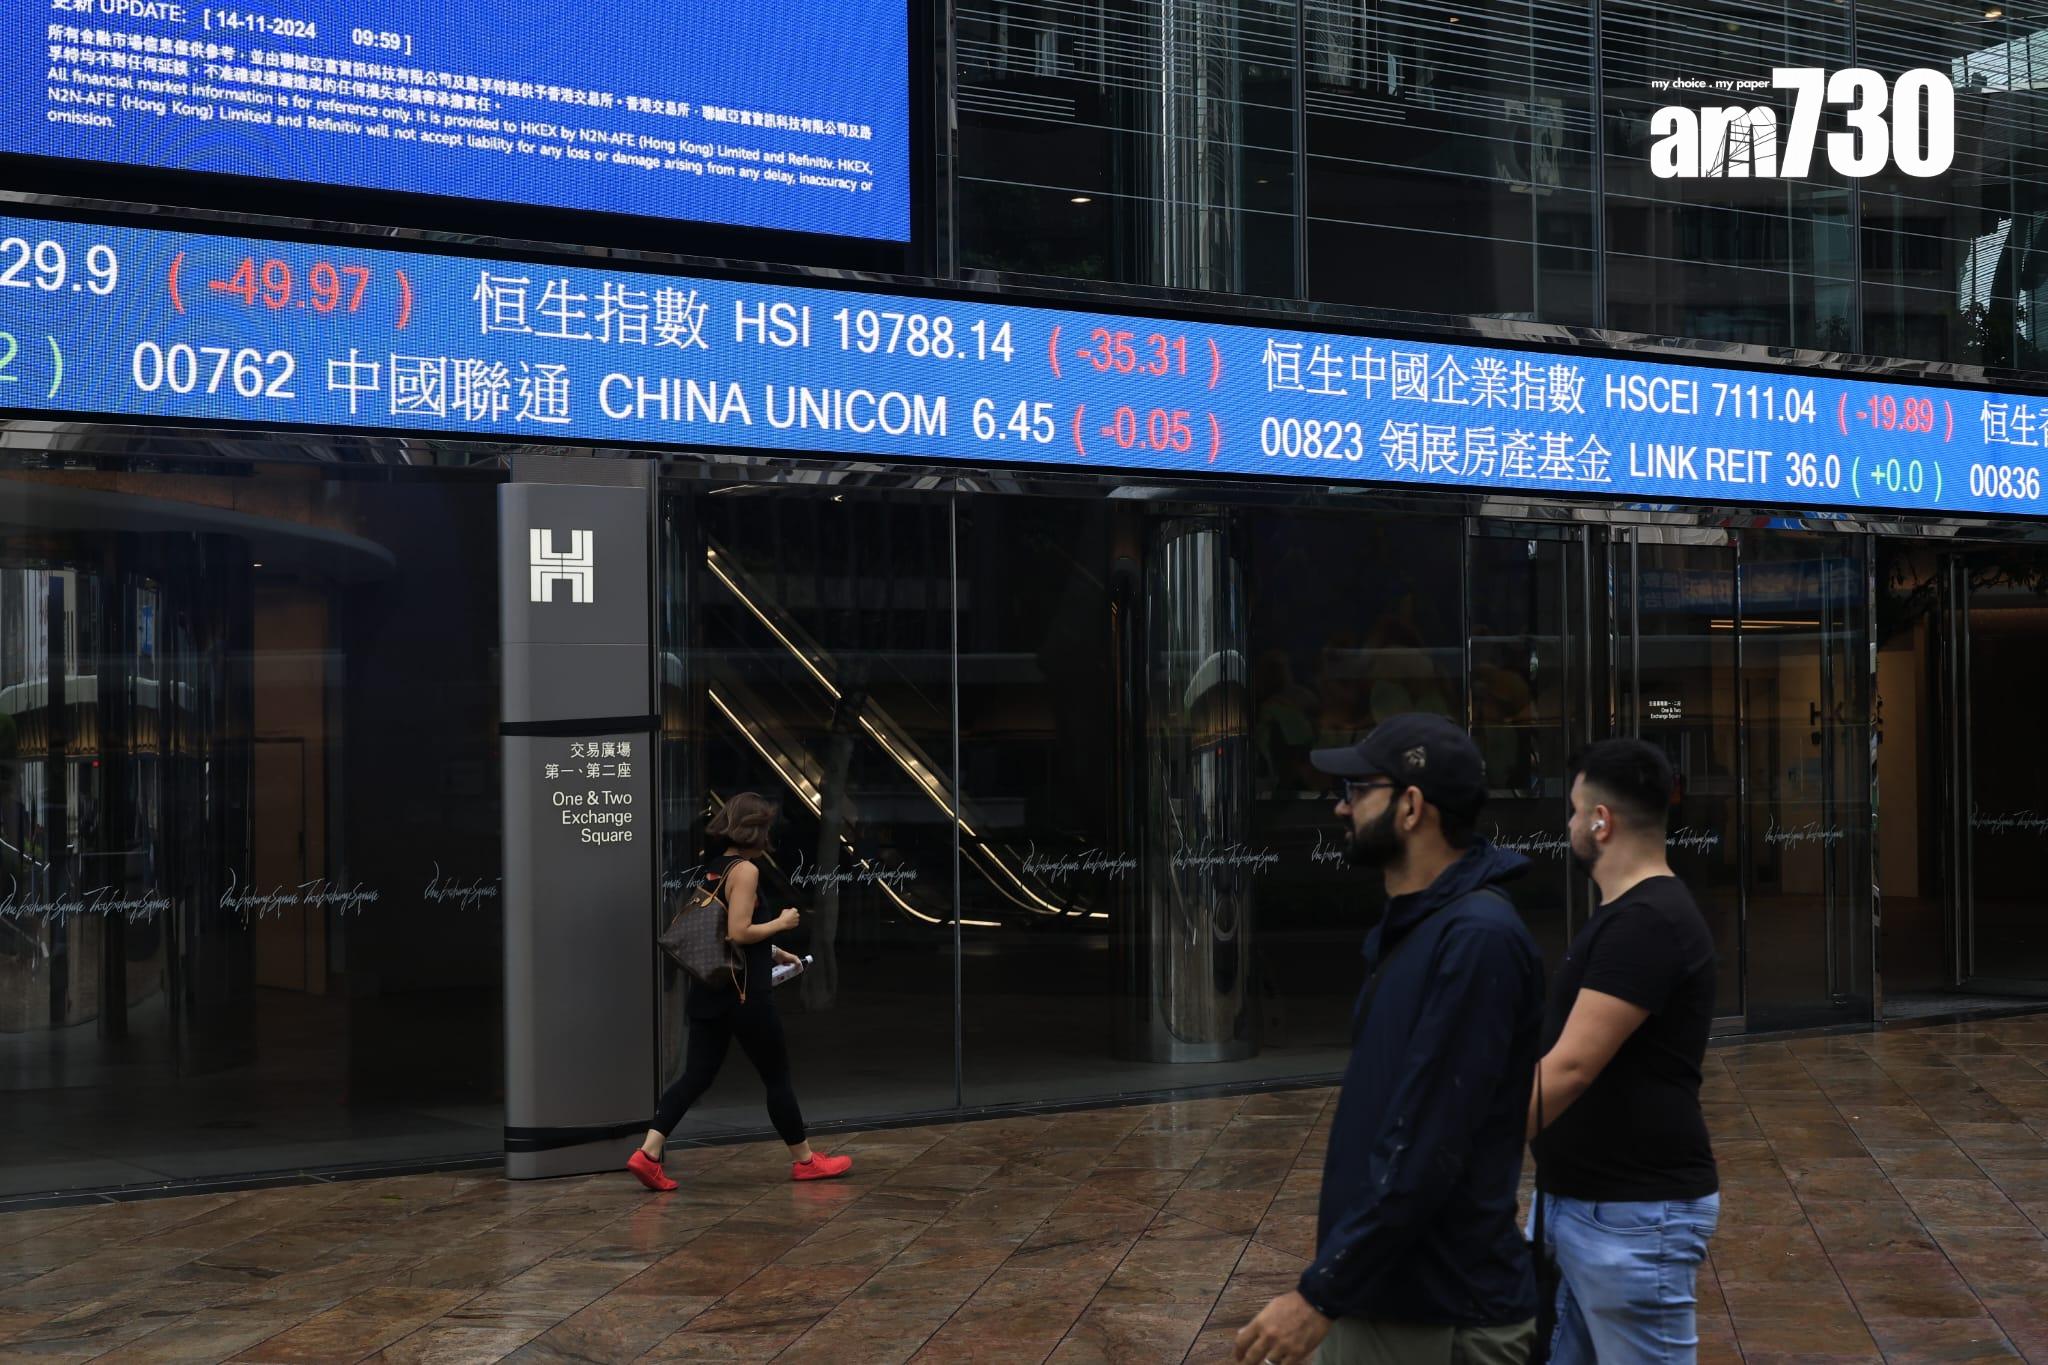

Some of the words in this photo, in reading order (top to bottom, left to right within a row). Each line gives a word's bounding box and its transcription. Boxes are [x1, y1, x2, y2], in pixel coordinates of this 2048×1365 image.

[101, 0, 186, 22] UPDATE:
[217, 10, 316, 39] 14-11-2024
[352, 28, 400, 50] 09:59
[48, 110, 115, 128] omission.
[48, 67, 68, 81] All
[72, 69, 133, 88] financial
[138, 80, 188, 95] market
[192, 84, 273, 104] information
[278, 94, 288, 107] is
[293, 95, 312, 109] for
[317, 100, 379, 117] reference
[382, 107, 412, 124] only.
[416, 109, 425, 122] It
[430, 111, 440, 124] is
[444, 114, 499, 131] provided
[504, 121, 517, 133] to
[521, 122, 558, 138] HKEX
[560, 126, 576, 142] by
[580, 128, 636, 147] N2N-AFE
[638, 135, 676, 154] (Hong
[680, 140, 714, 158] Kong)
[718, 144, 760, 161] Limited
[764, 152, 784, 164] and
[788, 152, 836, 170] Refinitiv.
[838, 159, 873, 176] HKEX,
[48, 86, 115, 107] N2N-AFE
[122, 94, 166, 116] (Hong
[172, 100, 213, 120] Kong)
[220, 105, 271, 123] Limited
[277, 115, 302, 128] and
[307, 116, 362, 135] Refinitiv
[366, 124, 389, 138] will
[394, 128, 416, 141] not
[421, 131, 463, 148] accept
[467, 134, 514, 154] liability
[518, 140, 536, 154] for
[540, 145, 562, 160] any
[566, 146, 591, 160] loss
[594, 150, 608, 162] or
[612, 151, 660, 170] damage
[664, 158, 702, 175] arising
[707, 162, 735, 176] from
[739, 167, 760, 181] any
[764, 168, 796, 185] delay,
[800, 172, 857, 192] inaccuracy
[860, 181, 873, 192] or
[209, 256, 369, 312] -49.97
[473, 270, 709, 350] 恒生指數
[735, 300, 809, 348] HSI
[833, 307, 1015, 363] 19788.14
[1076, 328, 1187, 376] -35.31
[1262, 338, 1586, 416] 恒生中國企業指數
[1605, 374, 1698, 415] HSCEI
[1712, 382, 1816, 424] 7111.04
[1855, 394, 1935, 434] -19.89
[1980, 400, 2048, 448] 恒生
[132, 340, 296, 399] 00762
[327, 347, 572, 424] 中國聯通
[599, 373, 752, 426] CHINA
[766, 384, 947, 437] UNICOM
[972, 398, 1055, 444] 6.45
[1101, 406, 1192, 452] -0.05
[1260, 416, 1364, 461] 00823
[1378, 418, 1613, 483] 領展房產基金
[1630, 442, 1698, 481] LINK
[1706, 446, 1773, 484] REIT
[1786, 452, 1841, 489] 36.0
[1870, 458, 1923, 494] +0.0
[1969, 462, 2040, 500] 00836
[545, 762, 632, 780] 第一、第二座
[552, 792, 582, 806] One
[587, 791, 600, 806] &
[602, 790, 632, 805] Two
[562, 810, 632, 826] Exchange
[582, 828, 632, 846] Square
